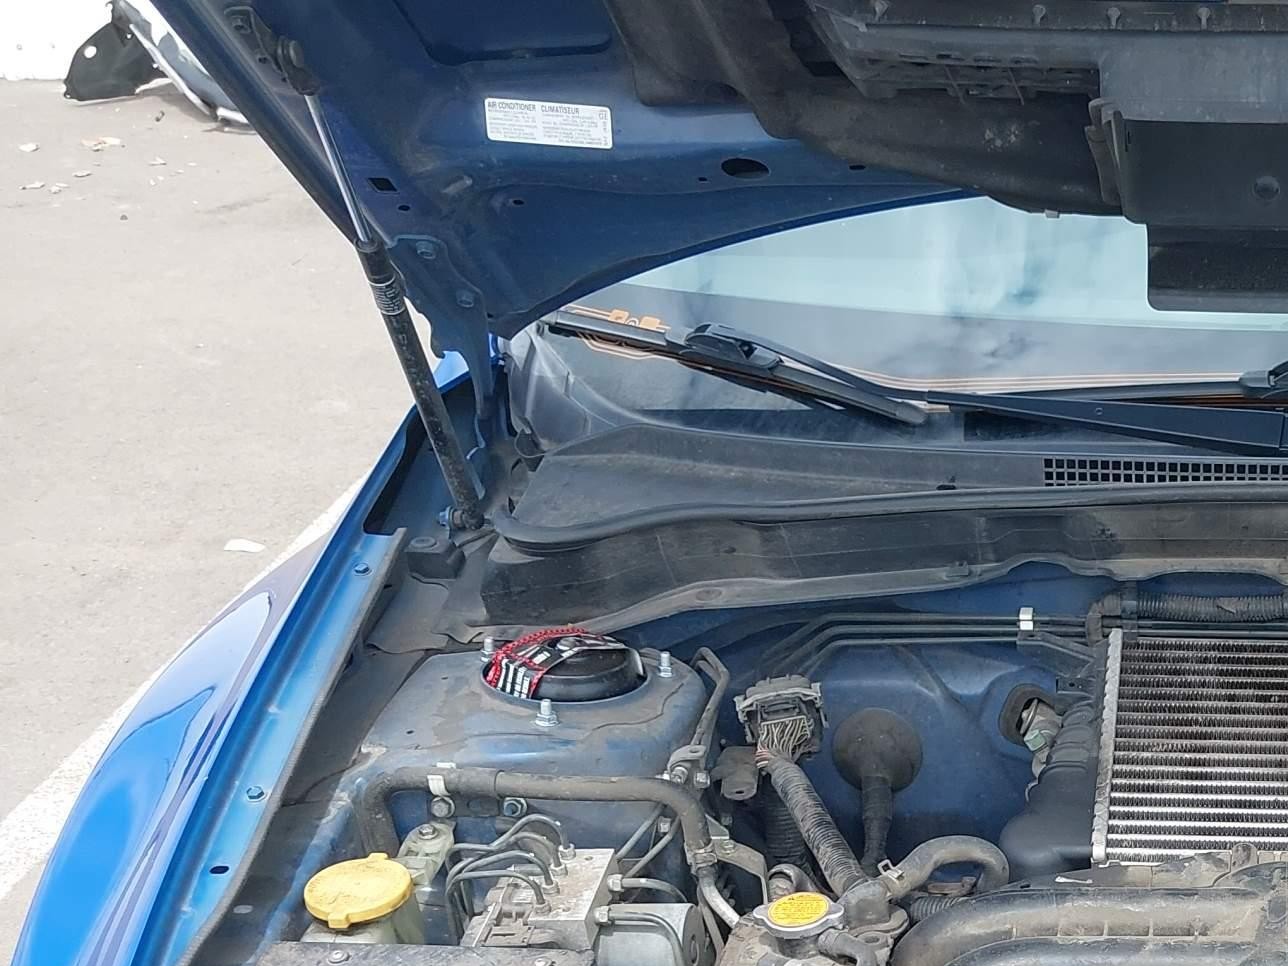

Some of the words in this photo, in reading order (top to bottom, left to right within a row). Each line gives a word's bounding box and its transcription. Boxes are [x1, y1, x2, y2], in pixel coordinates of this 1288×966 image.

[487, 101, 498, 109] AIR
[498, 102, 536, 111] CONDITIONER
[541, 105, 579, 114] CLIMATISEUR
